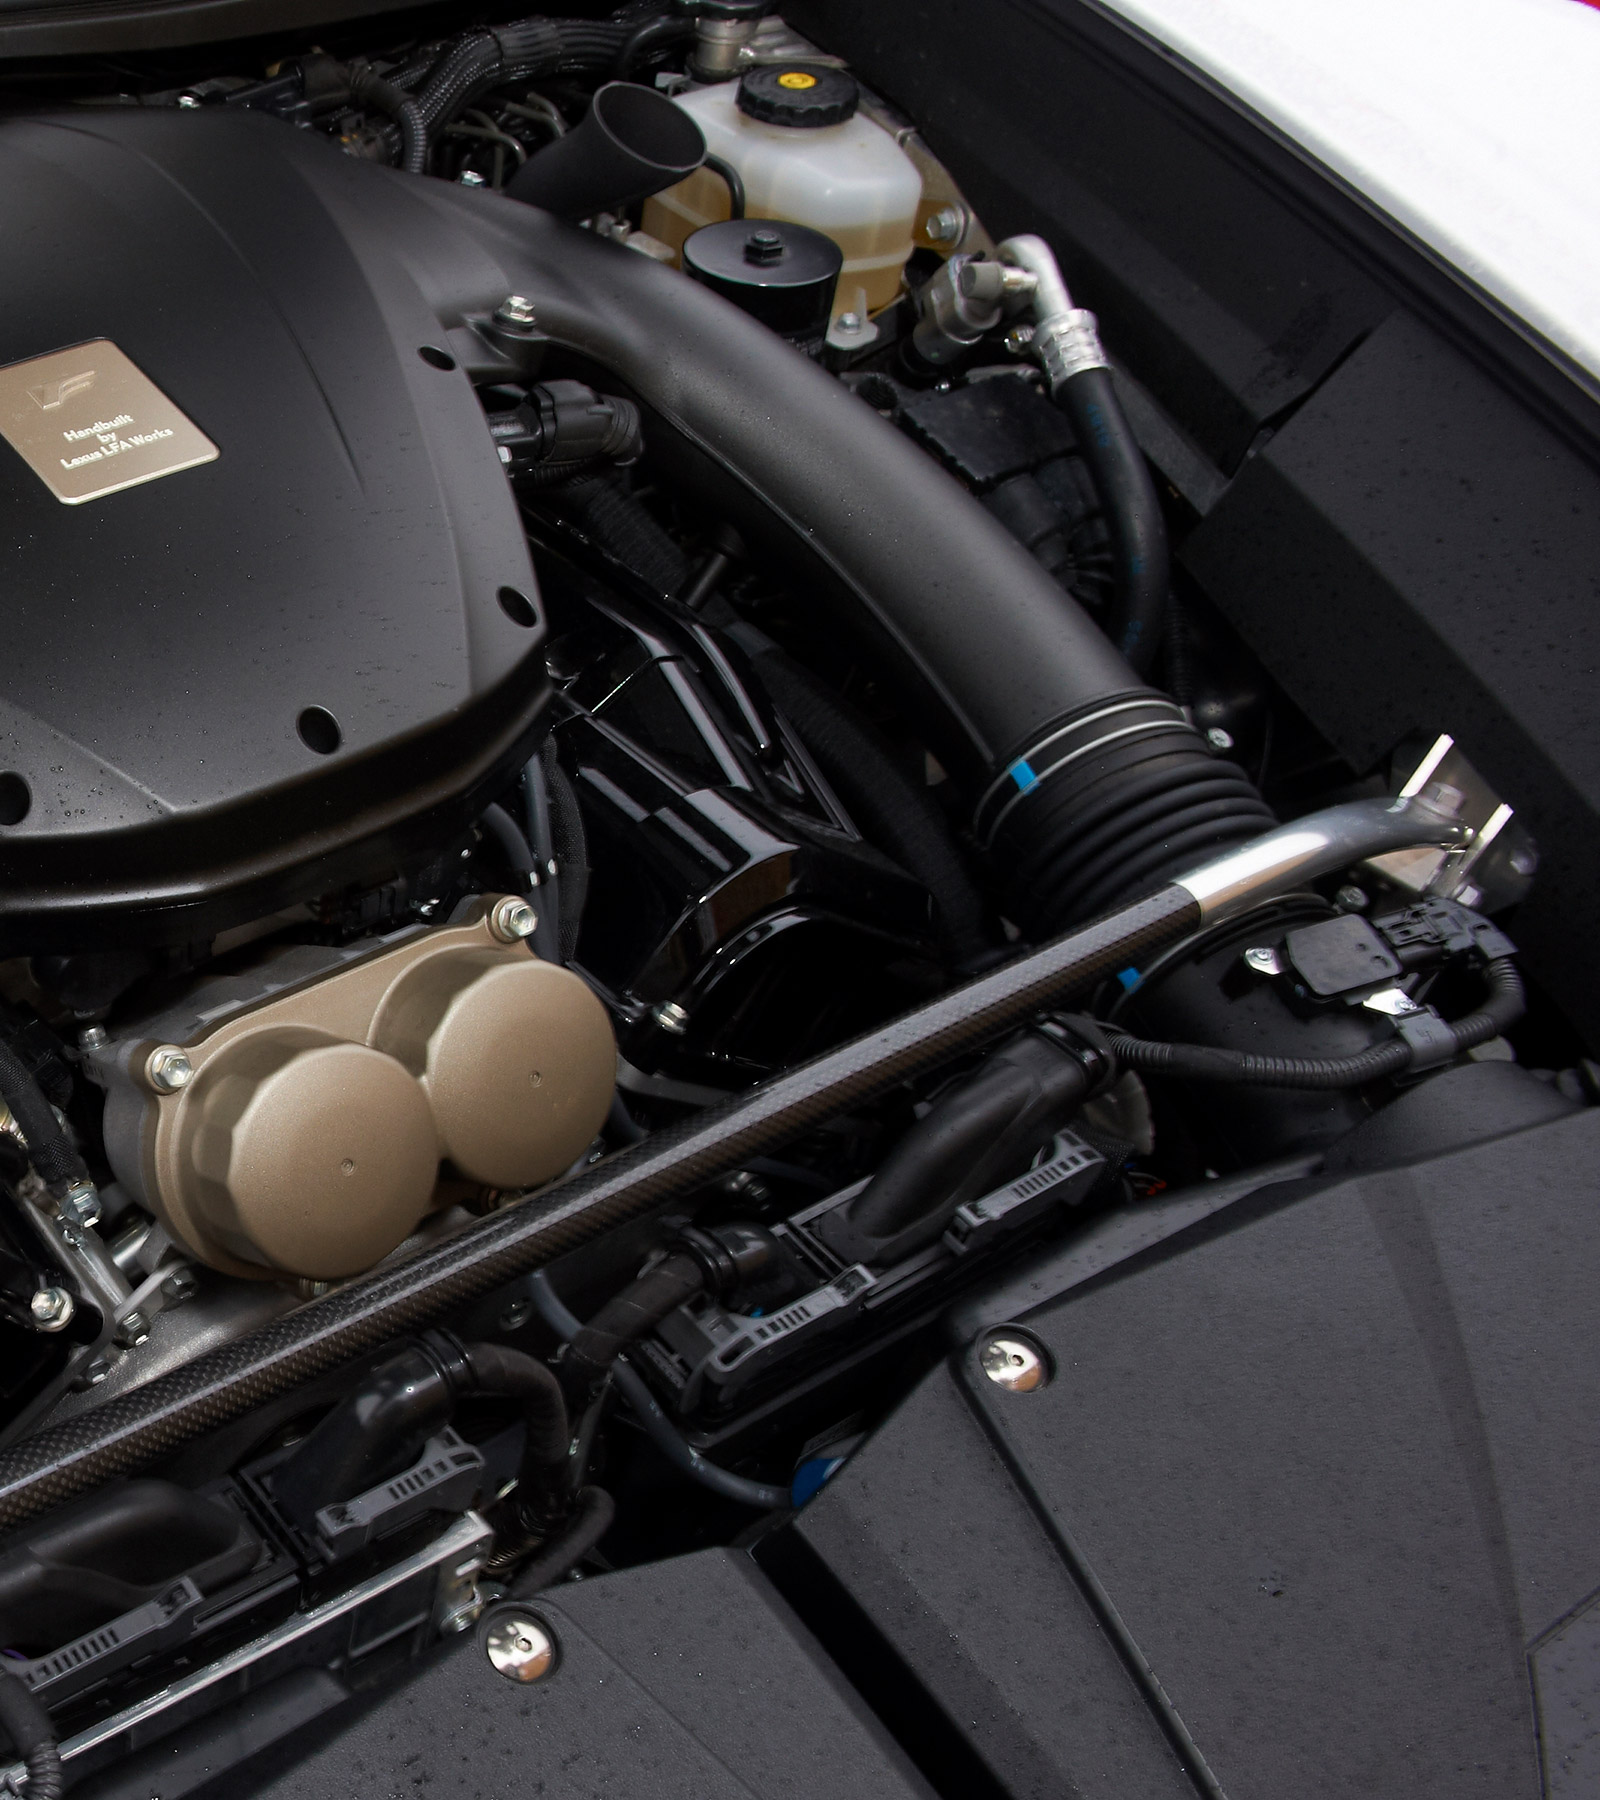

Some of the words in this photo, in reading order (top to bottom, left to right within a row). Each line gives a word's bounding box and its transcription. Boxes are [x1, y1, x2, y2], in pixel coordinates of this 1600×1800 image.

[63, 414, 134, 442] Handbuilt
[96, 432, 116, 444] by
[60, 450, 104, 470] Lexus
[100, 440, 133, 457] LFA
[128, 428, 174, 448] Works
